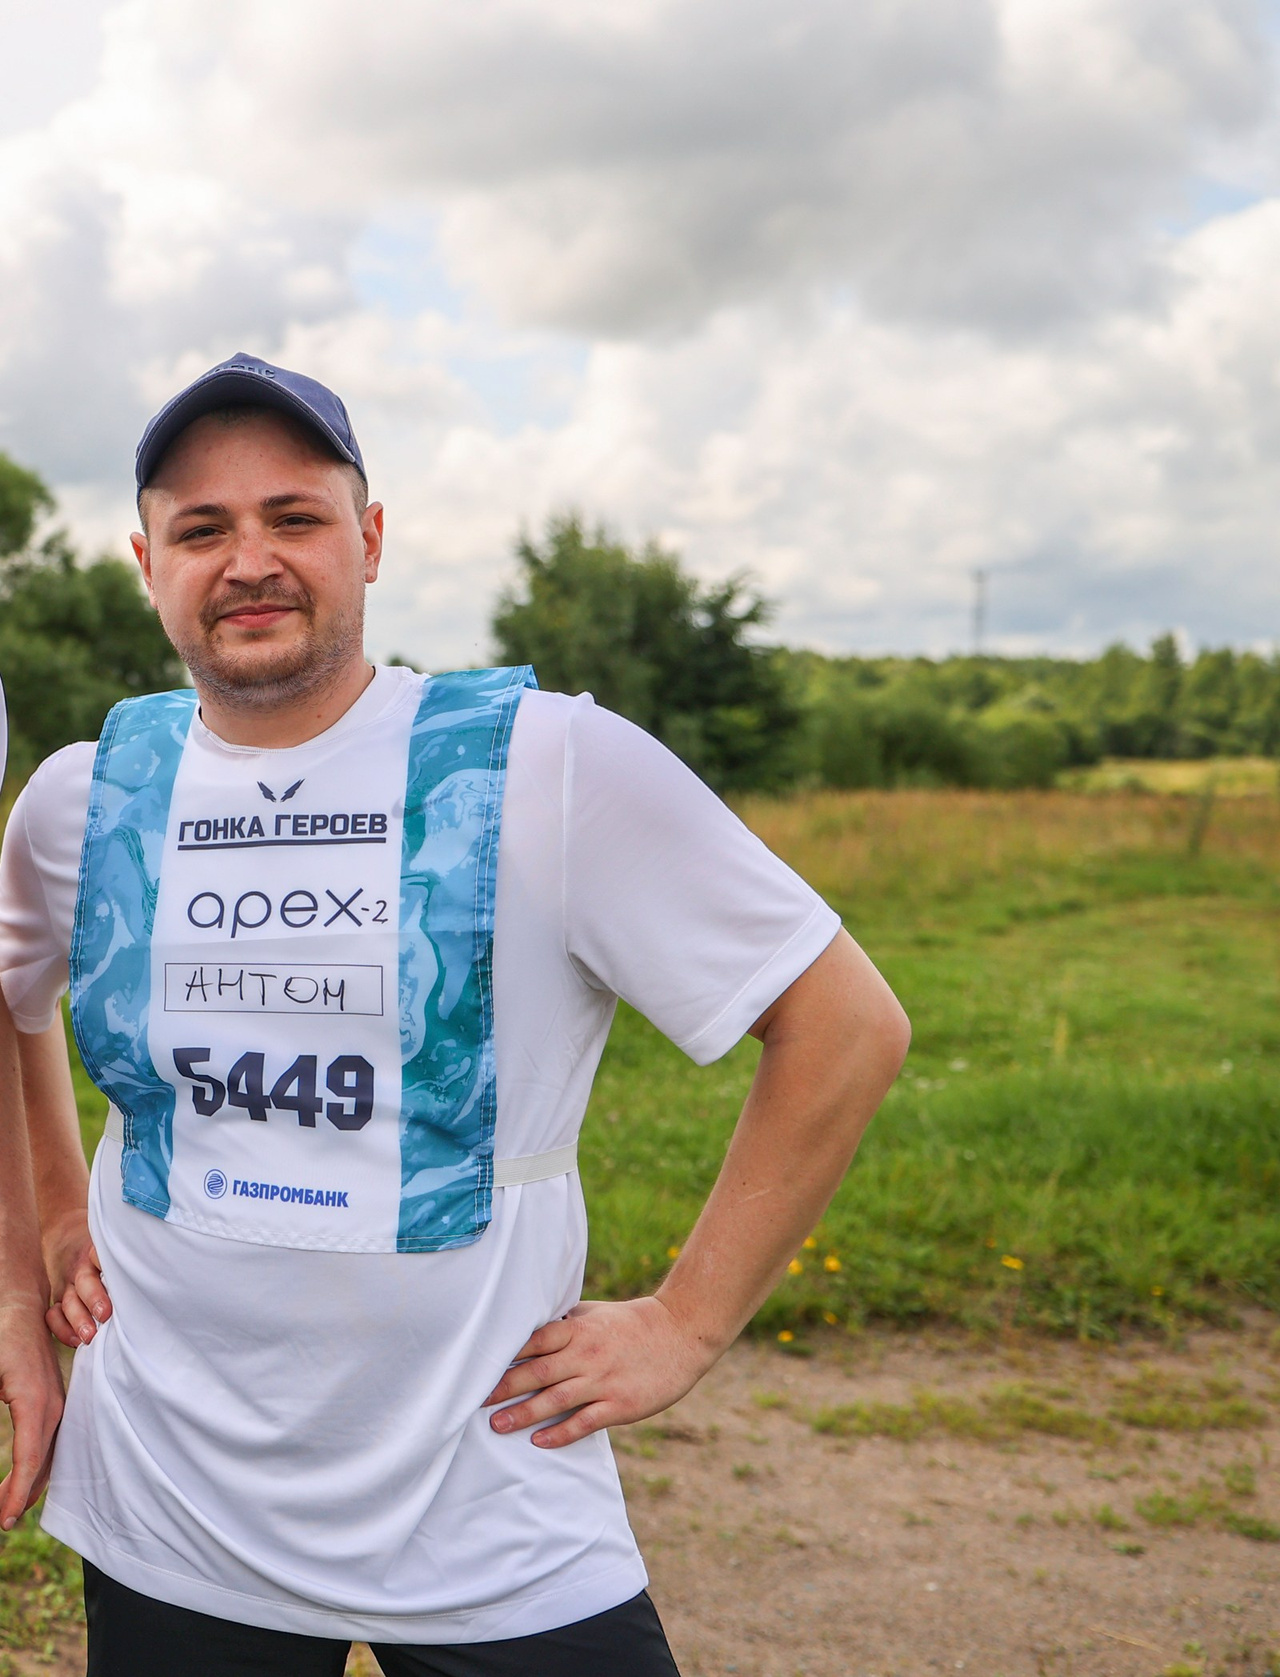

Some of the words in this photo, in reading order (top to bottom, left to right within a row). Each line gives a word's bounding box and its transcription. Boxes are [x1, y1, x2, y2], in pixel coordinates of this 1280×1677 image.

[178, 816, 265, 842] ГОНКА
[274, 813, 388, 836] ГЕРОЕВ
[172, 1047, 375, 1131] 5449
[232, 1179, 349, 1208] ГАЗПРОМБАНК
